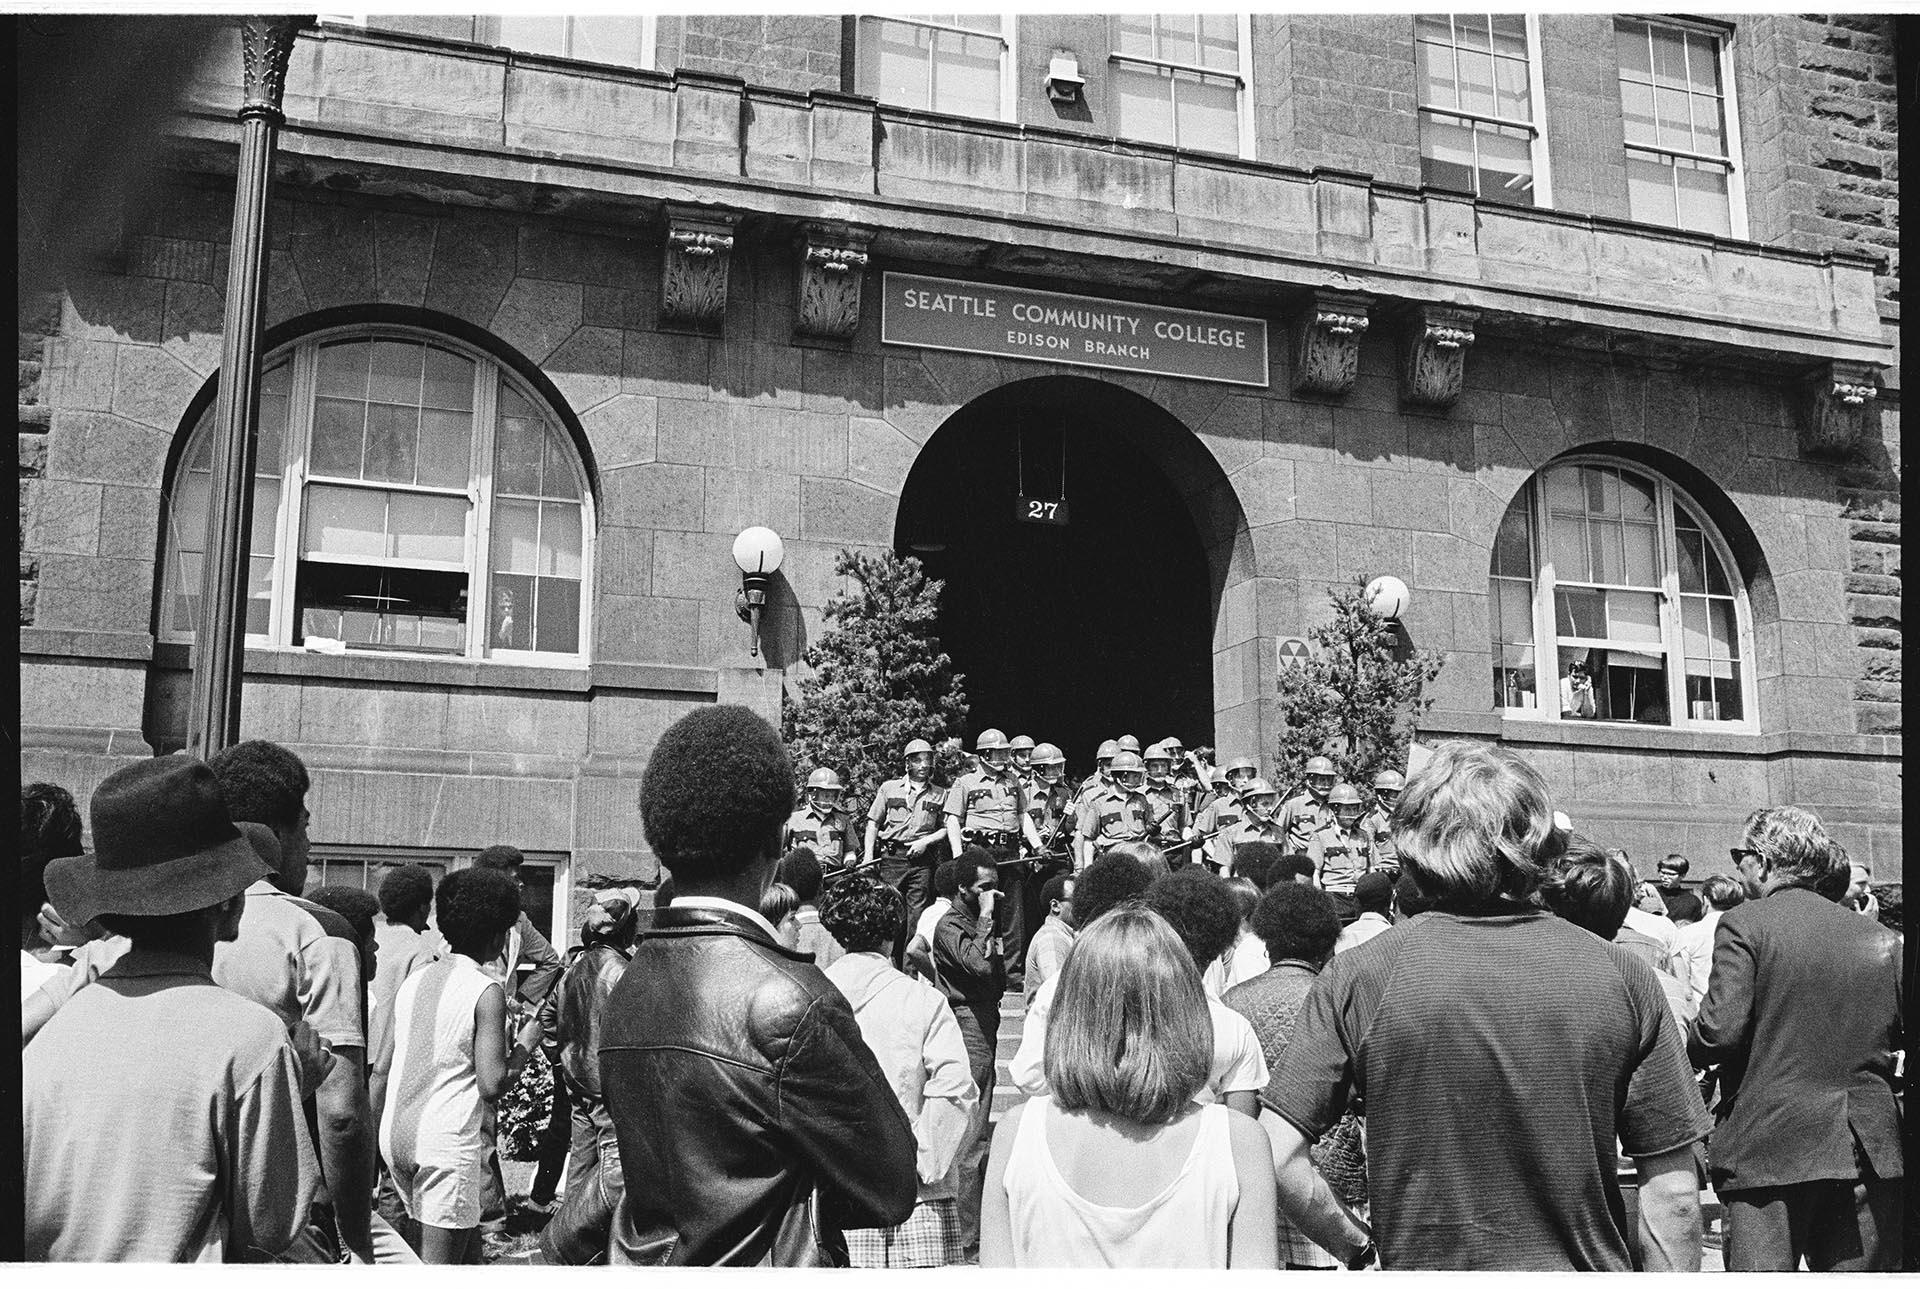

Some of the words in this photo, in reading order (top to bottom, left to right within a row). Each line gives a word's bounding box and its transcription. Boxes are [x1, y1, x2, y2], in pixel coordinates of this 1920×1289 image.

[904, 288, 996, 318] SEATTLE
[1012, 303, 1140, 335] COMMUNITY
[1154, 321, 1246, 349] COLLEGE
[1007, 331, 1070, 350] EDISON
[1084, 340, 1149, 360] BRANCH
[1028, 500, 1059, 520] 27
